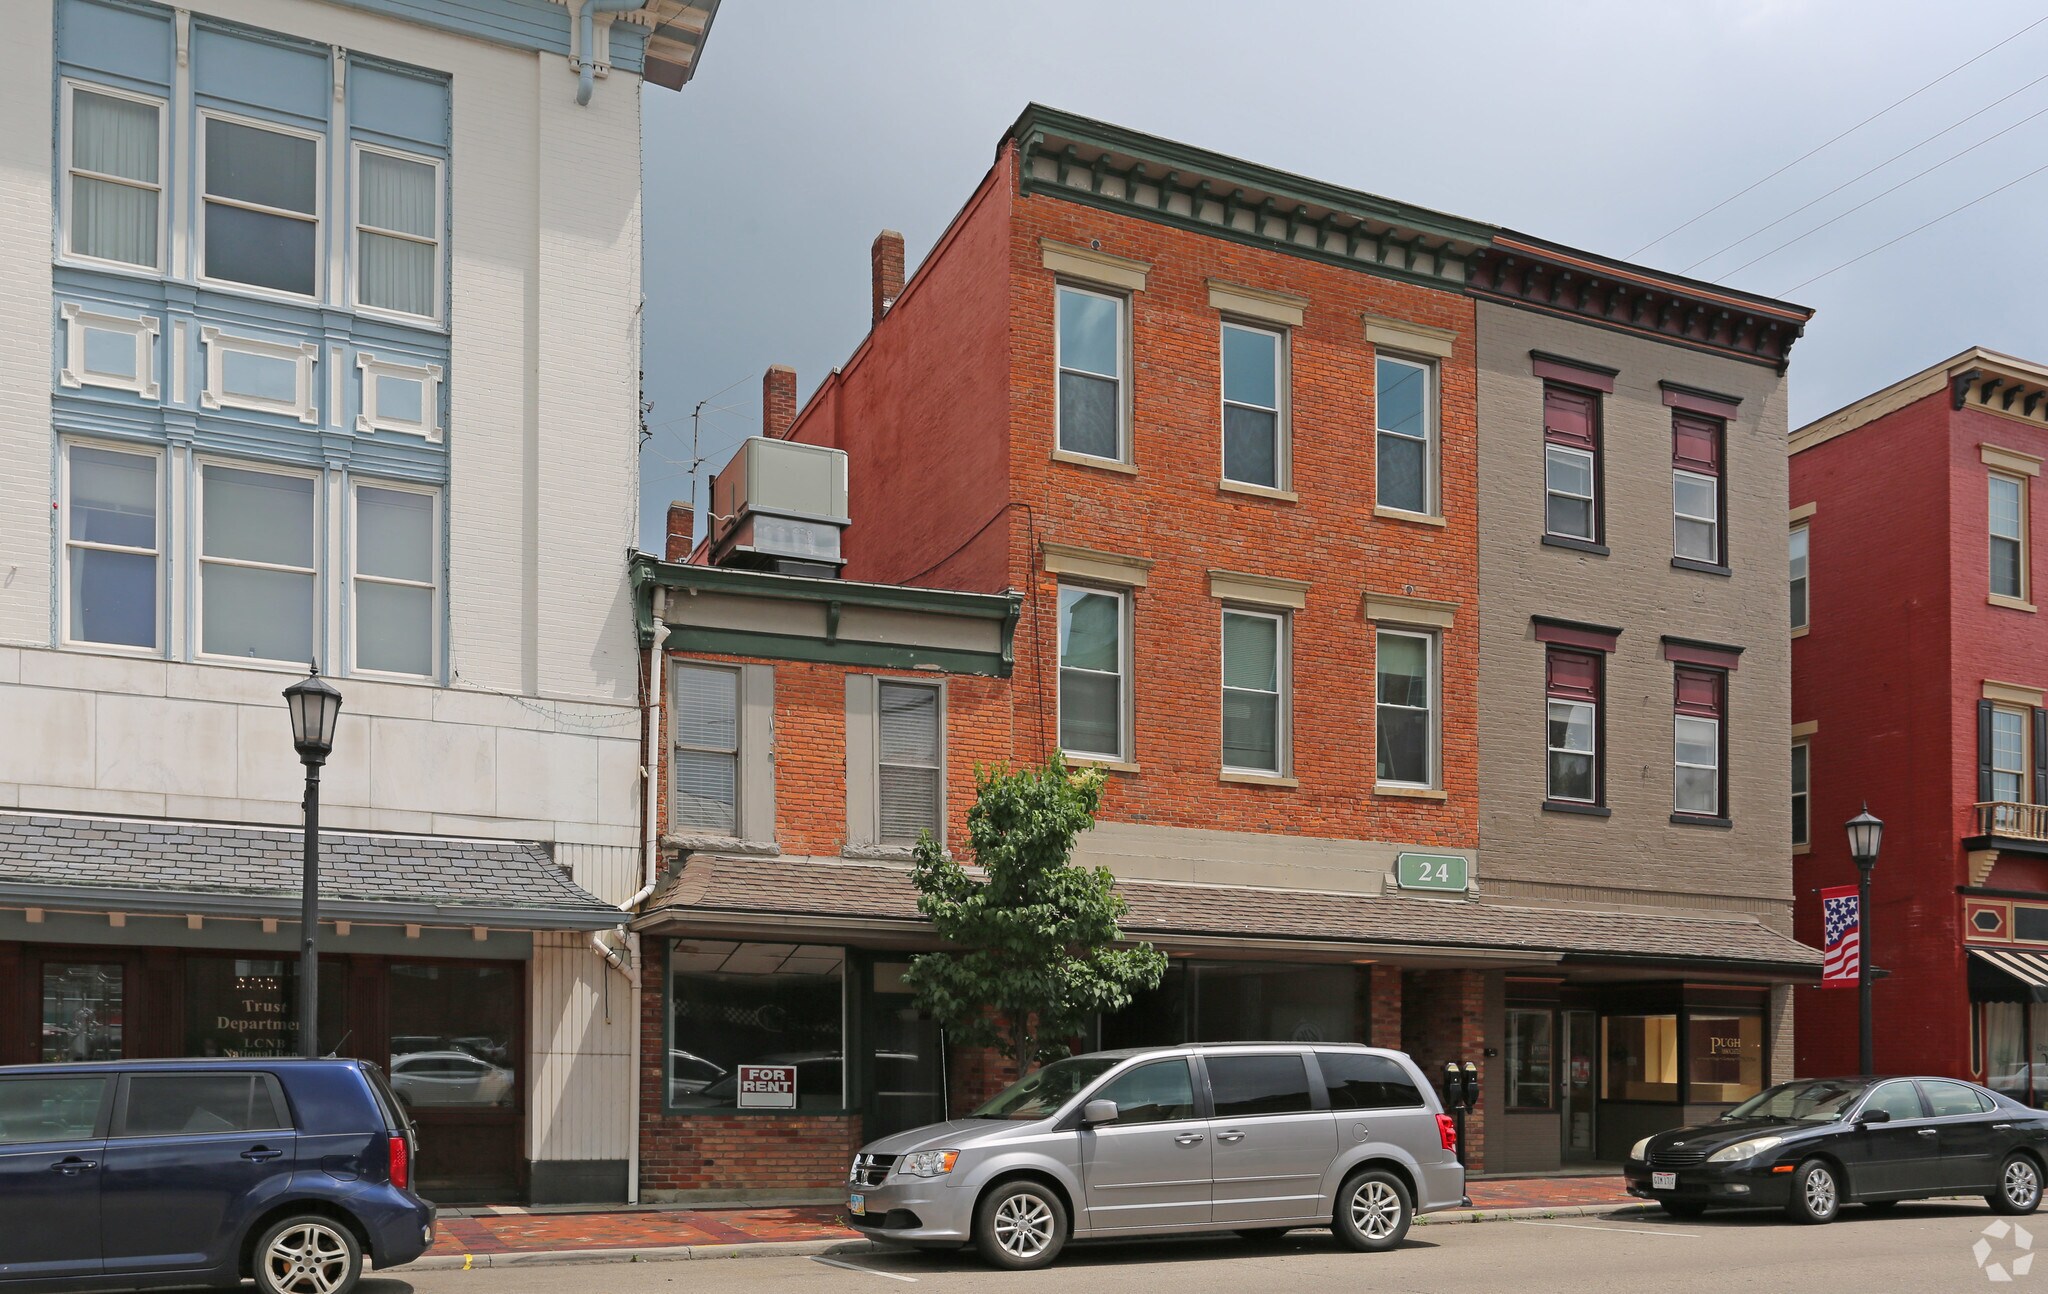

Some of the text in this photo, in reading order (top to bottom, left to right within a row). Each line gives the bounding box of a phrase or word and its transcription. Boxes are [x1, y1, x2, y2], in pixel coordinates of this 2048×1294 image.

[1418, 862, 1449, 883] 24
[242, 999, 287, 1013] Trust
[217, 1016, 300, 1033] Departme
[244, 1039, 286, 1049] LCNB
[1710, 1036, 1742, 1054] PUGH
[277, 1049, 299, 1058] Ban
[749, 1069, 786, 1081] FOR
[743, 1081, 792, 1092] RENT
